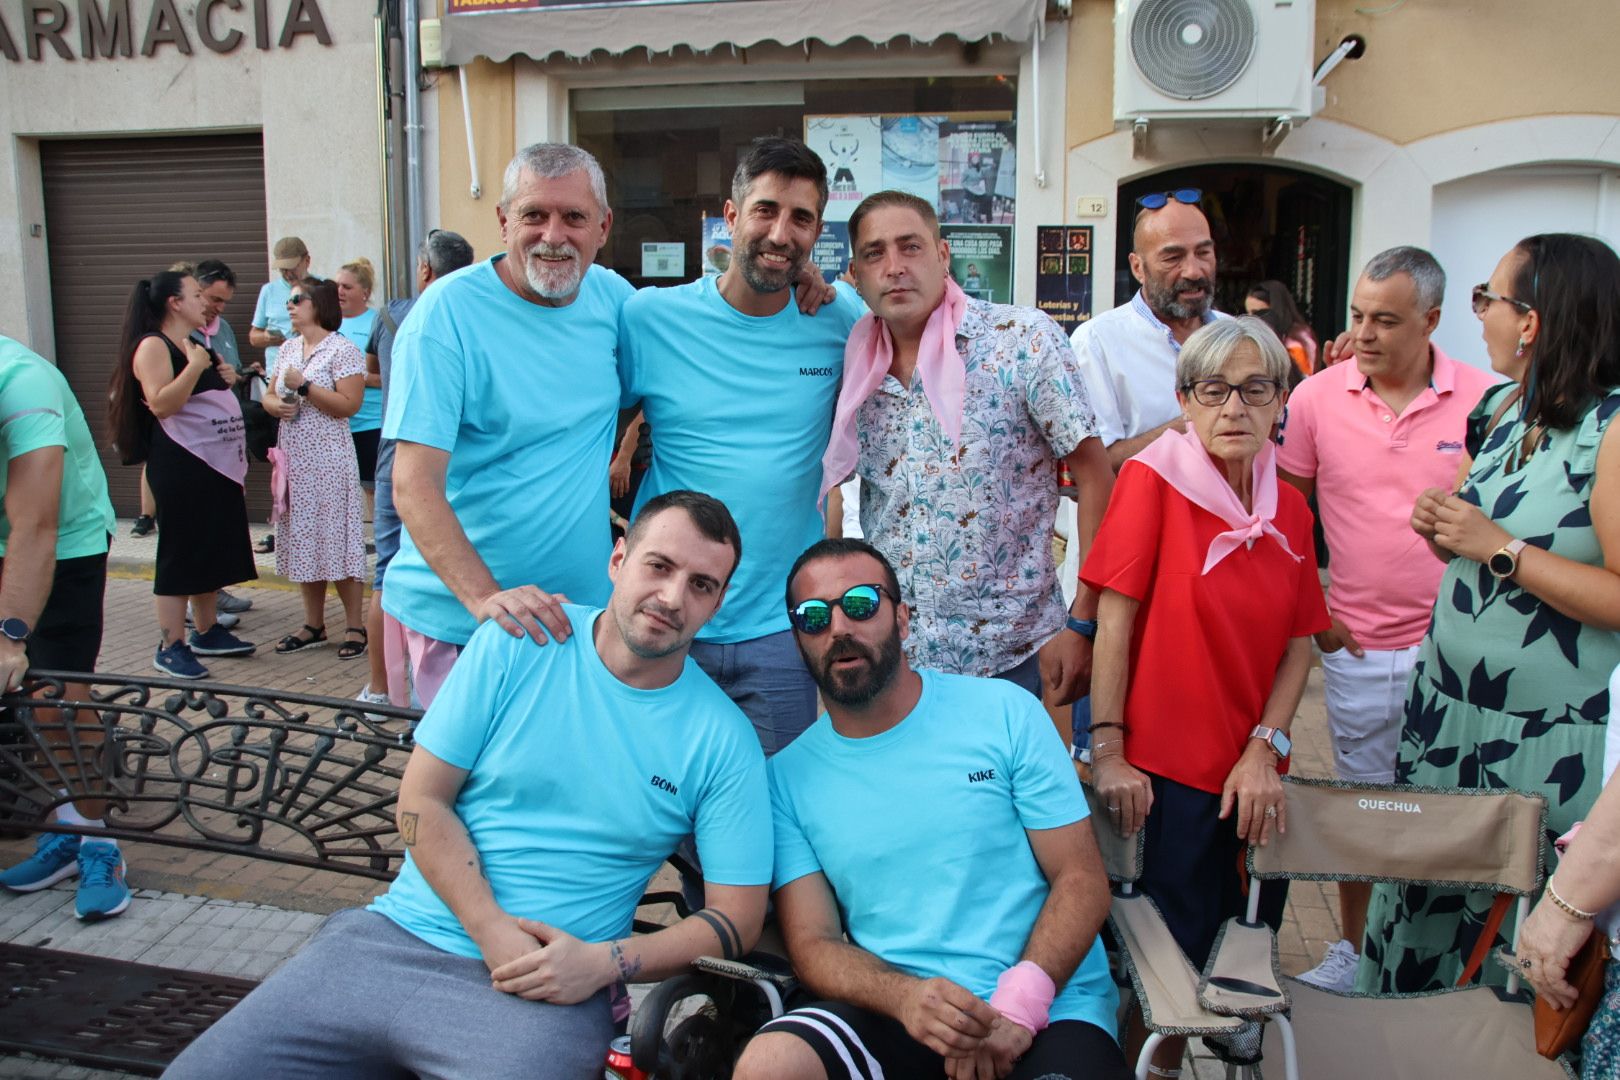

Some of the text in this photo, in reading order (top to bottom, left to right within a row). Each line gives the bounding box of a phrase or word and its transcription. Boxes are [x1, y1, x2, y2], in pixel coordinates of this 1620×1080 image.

[1091, 204, 1102, 212] 12
[1073, 303, 1079, 311] y
[799, 367, 833, 377] MARCOS
[968, 769, 996, 783] KIKE
[651, 775, 678, 796] BONI
[1358, 799, 1422, 813] QUECHUA
